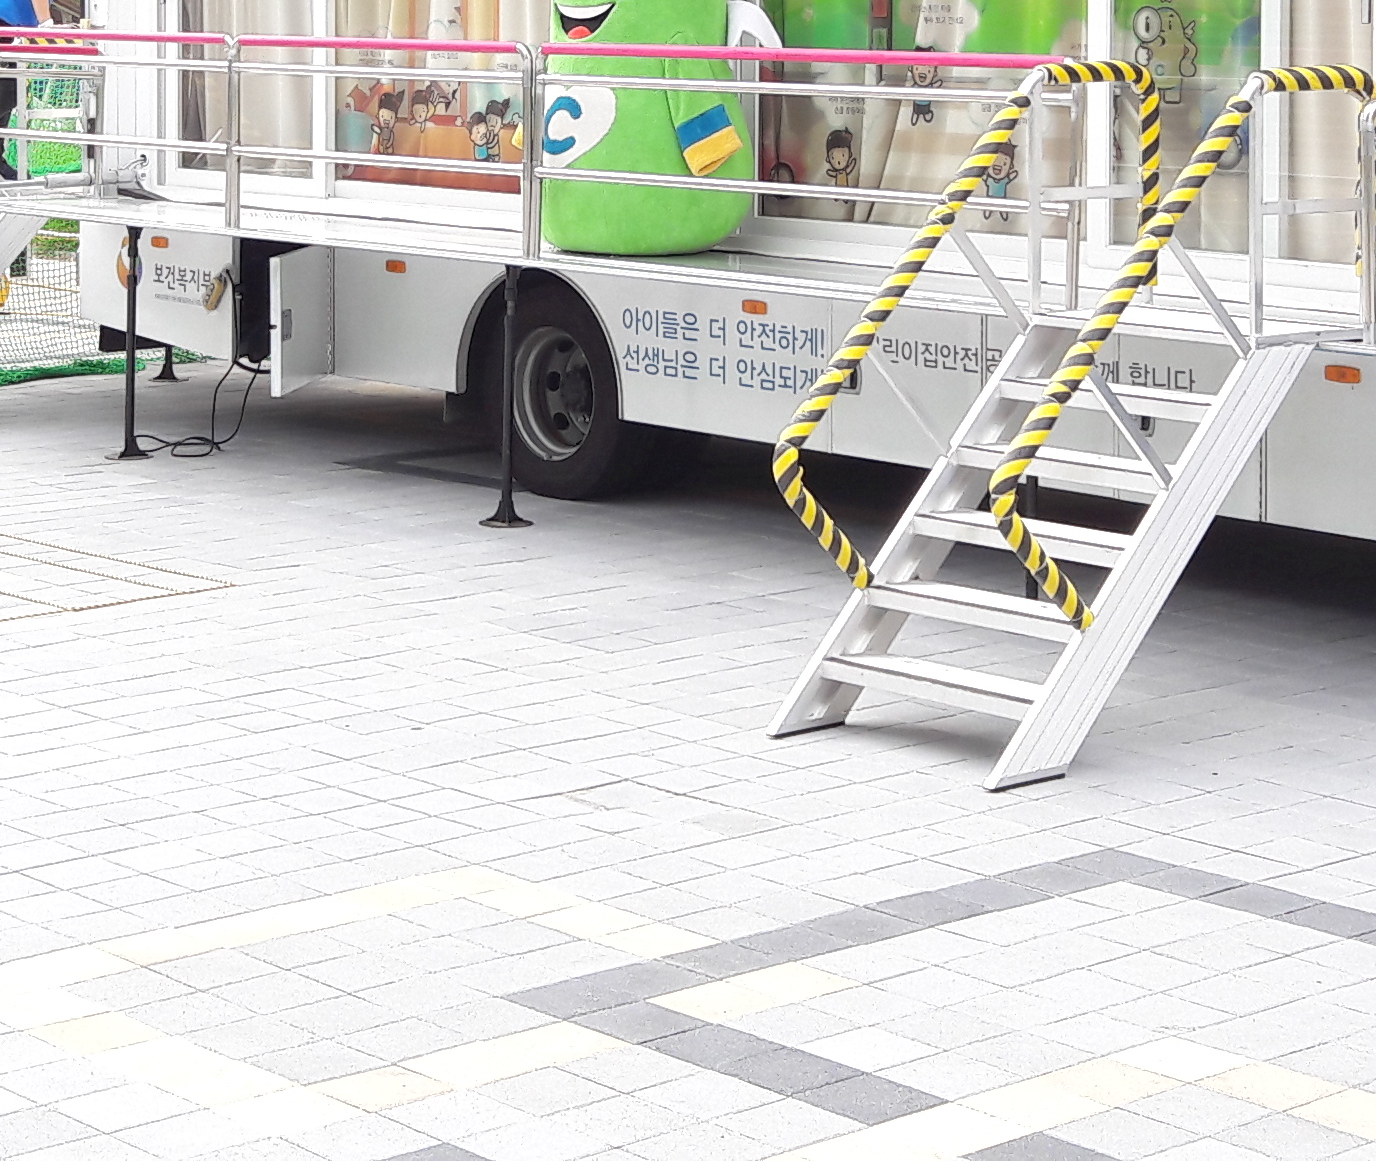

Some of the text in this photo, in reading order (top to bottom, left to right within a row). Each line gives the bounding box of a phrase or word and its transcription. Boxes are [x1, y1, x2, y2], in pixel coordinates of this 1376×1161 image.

[153, 262, 216, 293] 보건복지부
[622, 307, 825, 359] 아이들은 더 안전하게!
[622, 344, 825, 395] 선생님은 더 안심되게
